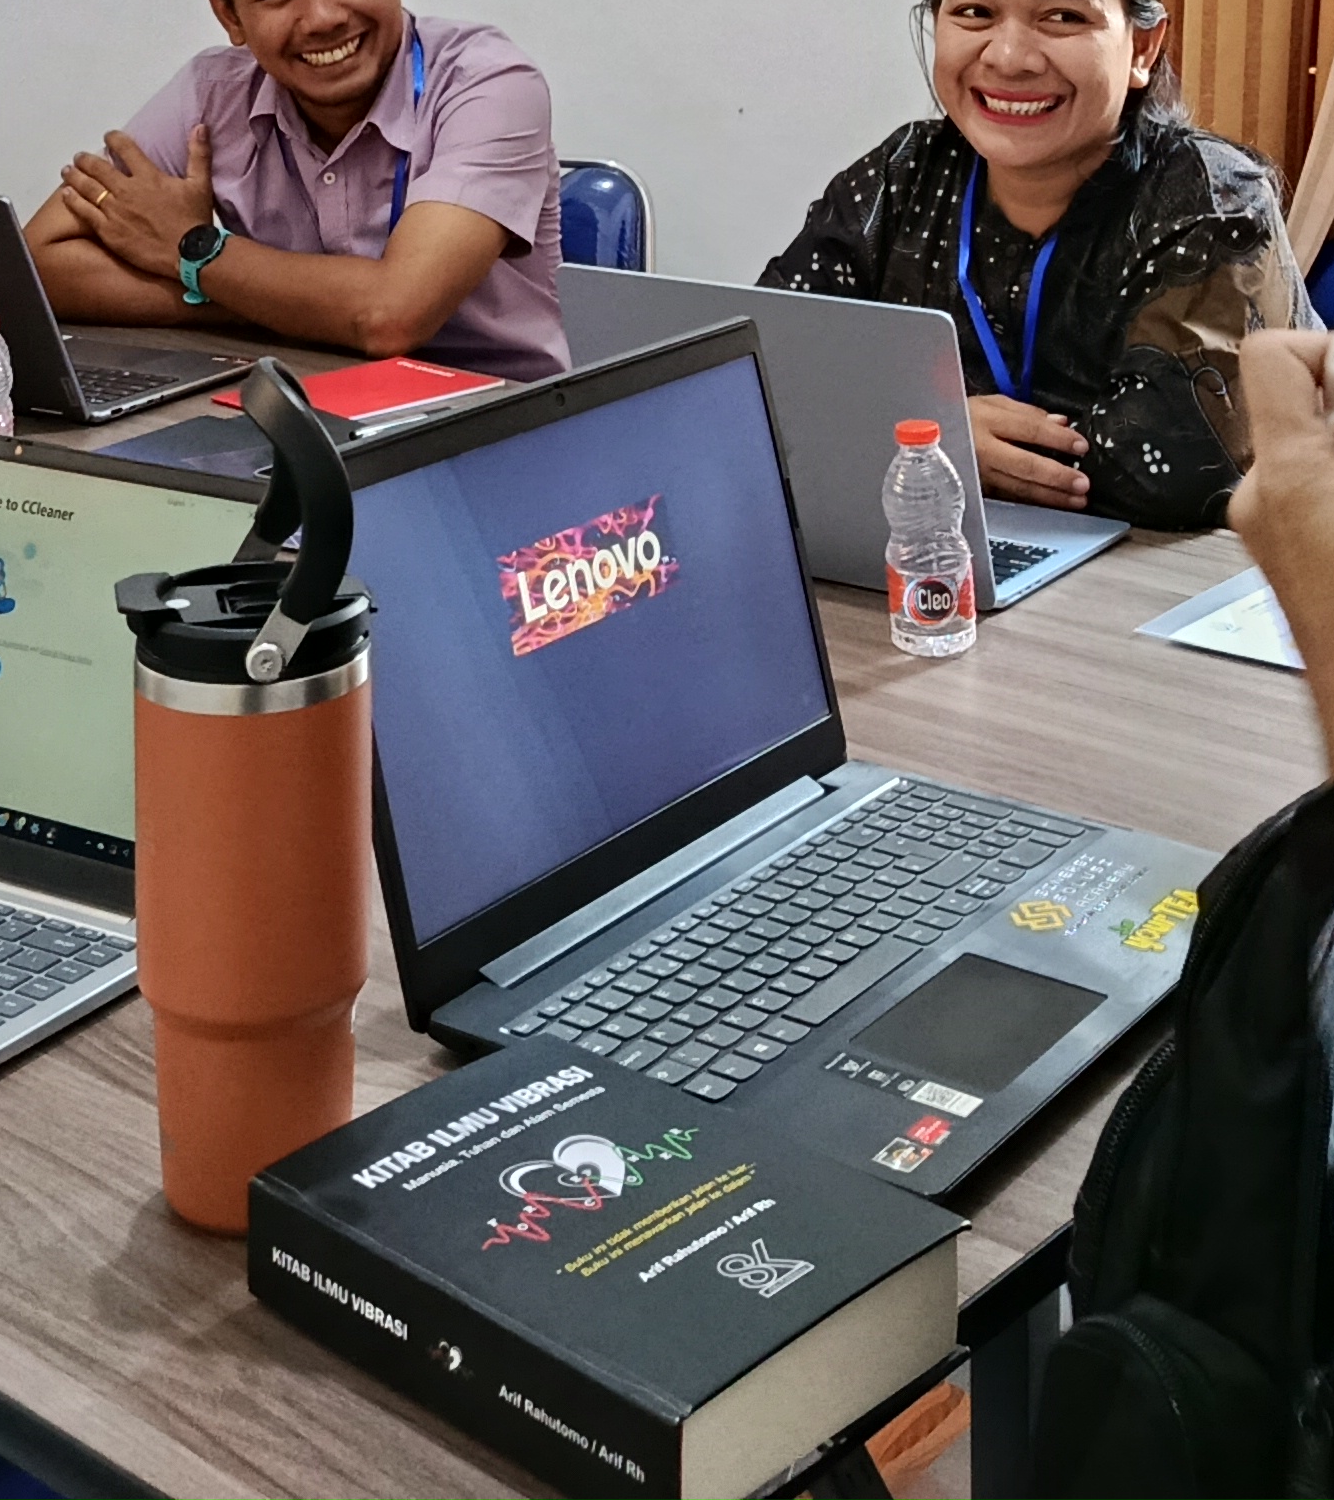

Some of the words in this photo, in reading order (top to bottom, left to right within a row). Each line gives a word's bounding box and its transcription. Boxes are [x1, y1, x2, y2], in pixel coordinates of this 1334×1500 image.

[5, 498, 19, 511] to
[21, 499, 75, 521] CCleaner
[517, 530, 661, 623] Lenovo
[917, 588, 951, 612] Cleo
[1075, 862, 1136, 908] ACADEMY
[352, 1141, 436, 1189] KITAB
[427, 1107, 500, 1147] ILMU
[489, 1065, 594, 1113] VIBRASI
[402, 1158, 464, 1191] Manusia,
[458, 1136, 501, 1159] Tuhan
[500, 1122, 525, 1140] dan
[523, 1109, 556, 1127] Alam
[552, 1086, 606, 1112] Semesta
[638, 1262, 666, 1283] Arif
[661, 1226, 728, 1267] Rahutomo
[731, 1207, 758, 1225] Arif
[752, 1198, 777, 1212] Rh
[272, 1246, 311, 1283] KITAB
[313, 1271, 349, 1304] ILMU
[351, 1293, 408, 1341] VIBRASI
[498, 1383, 522, 1409] Arif
[524, 1398, 589, 1449] Rahutomo
[598, 1445, 624, 1470] Arif
[625, 1459, 646, 1484] Rh
